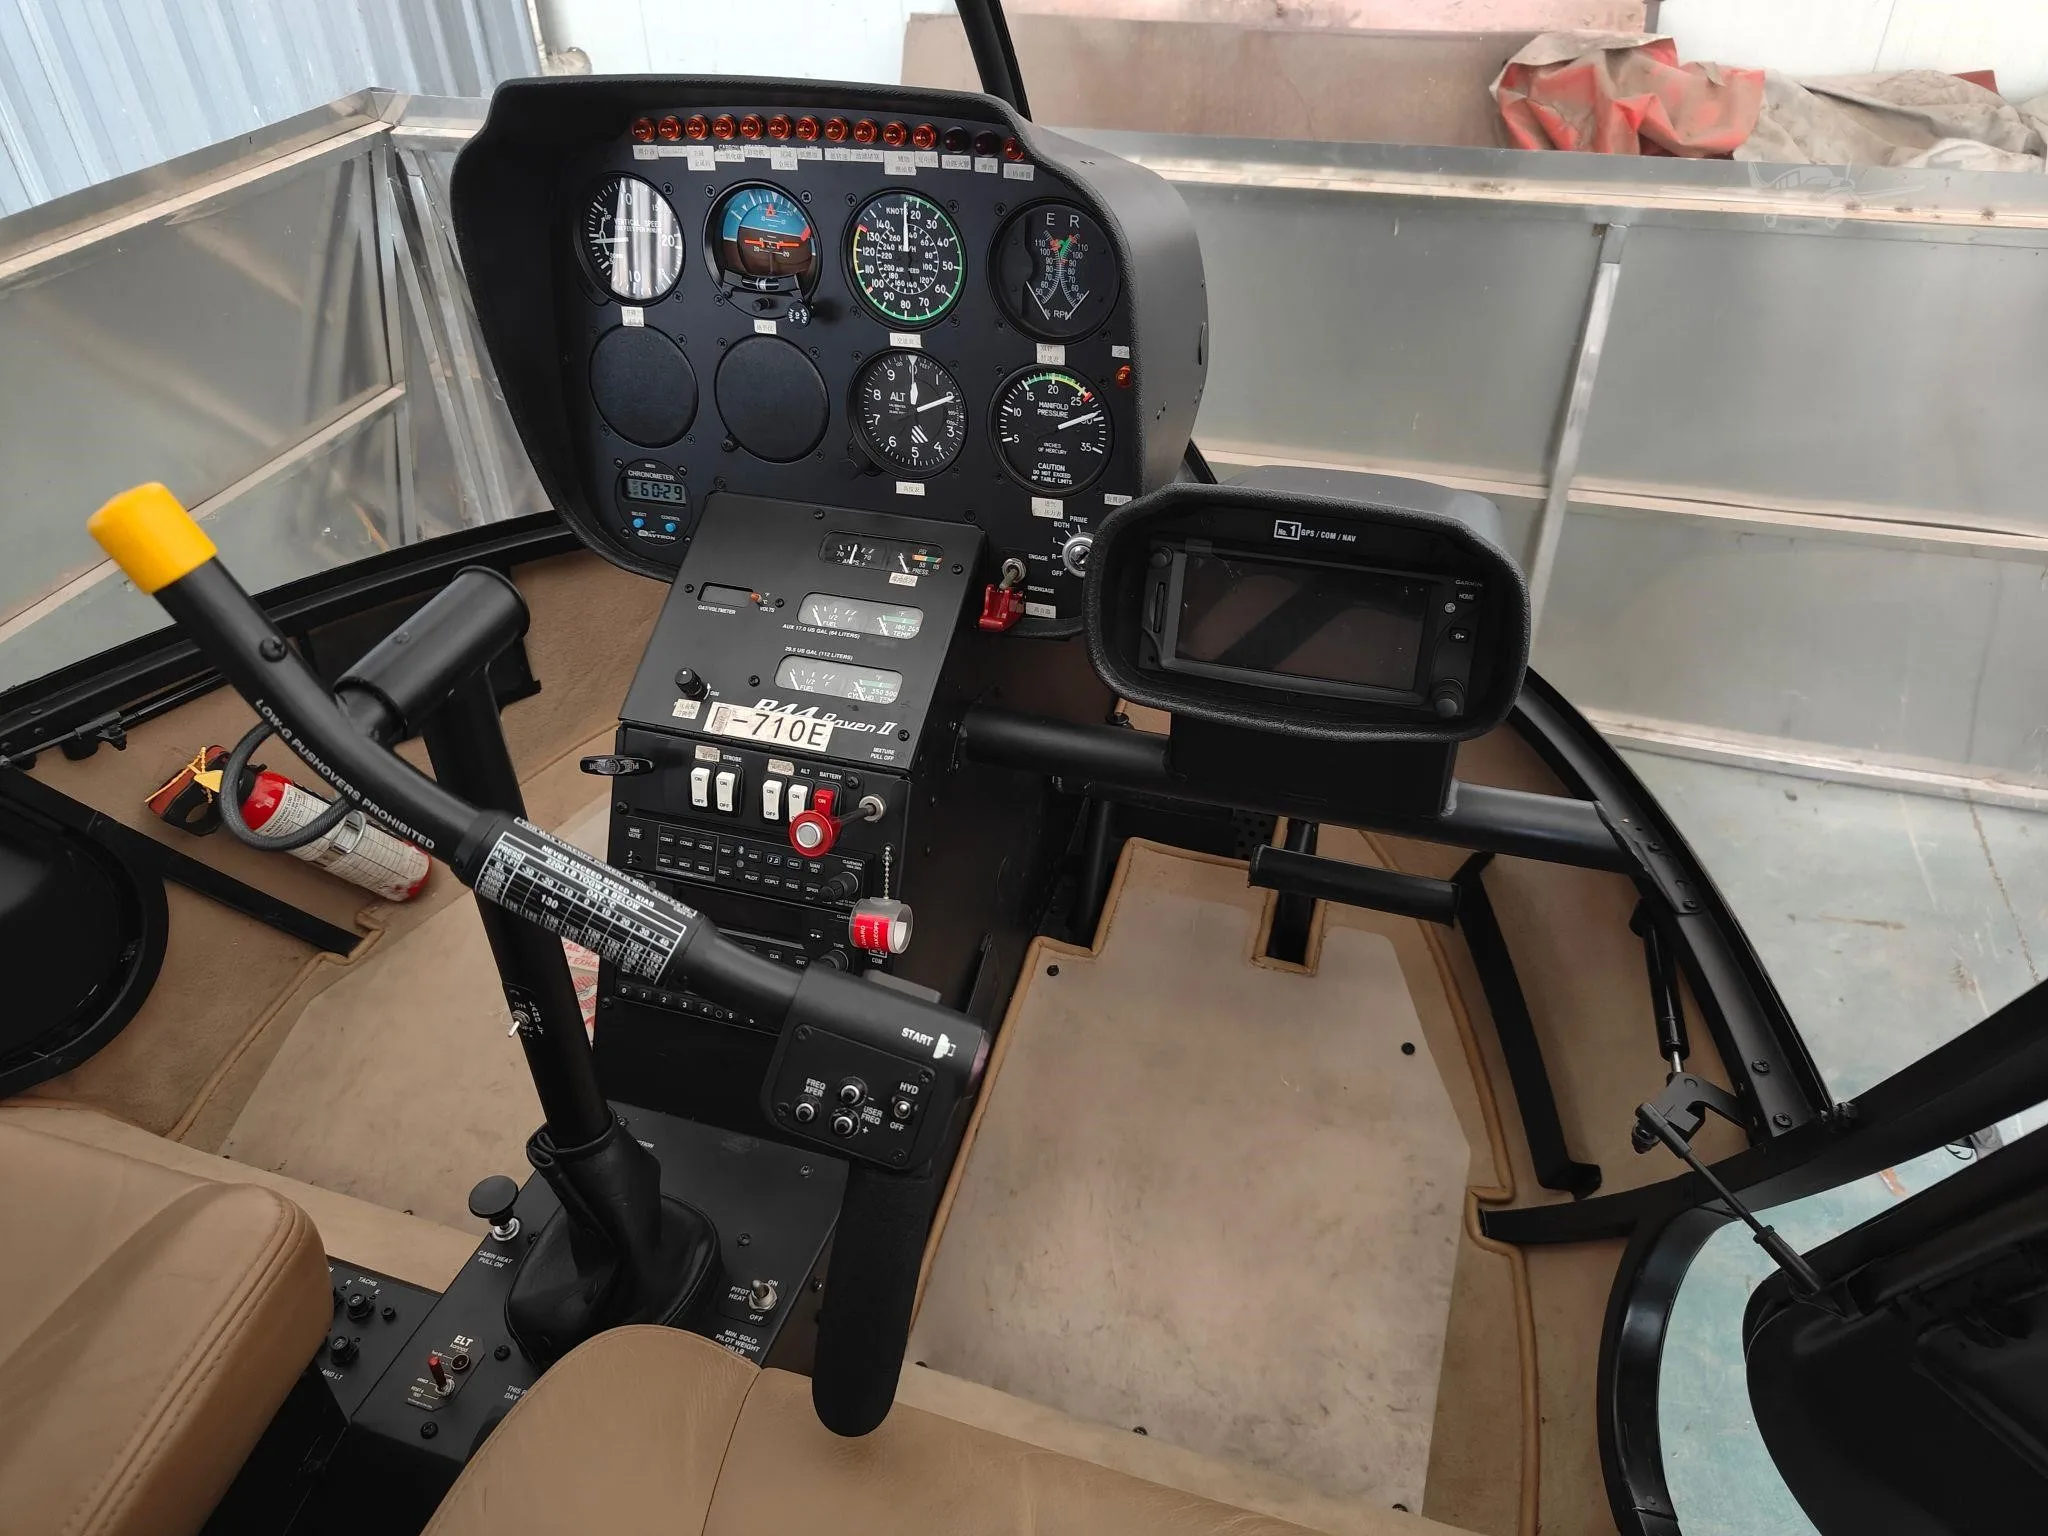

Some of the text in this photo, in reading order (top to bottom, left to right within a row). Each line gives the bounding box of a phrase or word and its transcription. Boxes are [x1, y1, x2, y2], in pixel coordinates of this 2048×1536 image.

[910, 210, 921, 220] 20
[1046, 212, 1056, 226] E
[876, 219, 890, 229] 140
[926, 219, 938, 229] 30
[1069, 215, 1079, 229] R
[661, 235, 675, 247] 20
[867, 232, 880, 242] 130
[937, 238, 949, 247] 40
[862, 247, 875, 256] 120
[865, 265, 875, 274] 110
[942, 261, 954, 270] 50
[629, 270, 641, 283] 10
[872, 279, 884, 288] 100
[935, 284, 946, 294] 60
[884, 291, 895, 301] 90
[900, 300, 911, 310] 80
[919, 297, 930, 307] 70
[887, 369, 896, 381] 9
[1048, 385, 1059, 394] 20
[873, 389, 882, 401] 8
[890, 392, 906, 402] ALT
[1026, 392, 1035, 401] 15
[1038, 401, 1069, 411] MANIFOLD
[1070, 397, 1082, 407] 25
[1013, 408, 1022, 417] 10
[1037, 409, 1069, 419] PRESSURE
[872, 413, 881, 425] 7
[946, 425, 955, 438] 3
[888, 436, 897, 447] 6
[1013, 434, 1020, 444] 5
[933, 441, 942, 452] 4
[1045, 447, 1067, 456] MERCURY
[1080, 442, 1092, 452] 35
[911, 446, 920, 458] 5
[1037, 462, 1066, 472] CAUTION
[628, 469, 675, 481] CHRONOMETER
[1052, 471, 1071, 479] EXCEED
[1057, 477, 1072, 485] LIMITS
[1053, 520, 1070, 529] BOTH
[1070, 515, 1088, 524] PRIME
[1290, 525, 1296, 537] 1
[1301, 529, 1315, 537] GPS
[1320, 531, 1336, 540] COM
[1342, 534, 1356, 542] NAV
[1028, 553, 1048, 562] ENGAGE
[1051, 569, 1064, 577] OFF
[816, 628, 828, 636] GAL
[838, 631, 860, 640] LITERS)
[806, 649, 818, 657] GAL
[831, 652, 854, 661] LITERS)
[873, 746, 895, 756] MIXTURE
[722, 754, 742, 763] STROBE
[255, 699, 293, 740] LOW-G
[291, 737, 361, 801] PUSHOVERS
[361, 797, 435, 850] PROHIBITED
[800, 767, 811, 775] ALT
[819, 770, 841, 780] BATTERY
[497, 843, 523, 860] PRESS
[698, 843, 713, 851] COM3
[495, 861, 505, 873] SL
[842, 859, 863, 867] GARMIN
[541, 844, 569, 863] NEVER
[570, 859, 603, 880] EXCEED
[603, 877, 630, 895] SPEED
[635, 893, 655, 908] KIAS
[744, 874, 758, 882] PILOT
[545, 857, 641, 911] 2200 LB TOGW BELOW
[764, 878, 780, 886] COPLT
[786, 882, 798, 890] PASS
[540, 894, 559, 910] 130
[602, 907, 612, 917] 10
[620, 917, 631, 927] 20
[639, 926, 650, 937] 30
[659, 937, 670, 947] 40
[901, 1027, 934, 1046] START
[806, 1078, 826, 1090] FREQ
[899, 1082, 919, 1095] HYD
[804, 1086, 824, 1098] XFER
[863, 1105, 883, 1118] USER
[861, 1113, 881, 1125] FREQ
[890, 1121, 904, 1132] OFF
[478, 1250, 513, 1264] CABIN HEAT
[478, 1257, 493, 1266] PULL
[358, 1276, 378, 1287] TACHS
[767, 1279, 779, 1287] ON
[730, 1286, 750, 1296] PITOT
[728, 1293, 747, 1302] HEAT
[749, 1314, 764, 1322] OFF
[453, 1335, 474, 1347] ELT
[725, 1329, 758, 1344] MIN. SOLO
[715, 1333, 760, 1352] PILOT WEIGHT
[735, 1347, 745, 1355] LB
[334, 1373, 344, 1381] LT
[507, 1385, 521, 1395] THIS
[504, 1392, 518, 1401] DAY
